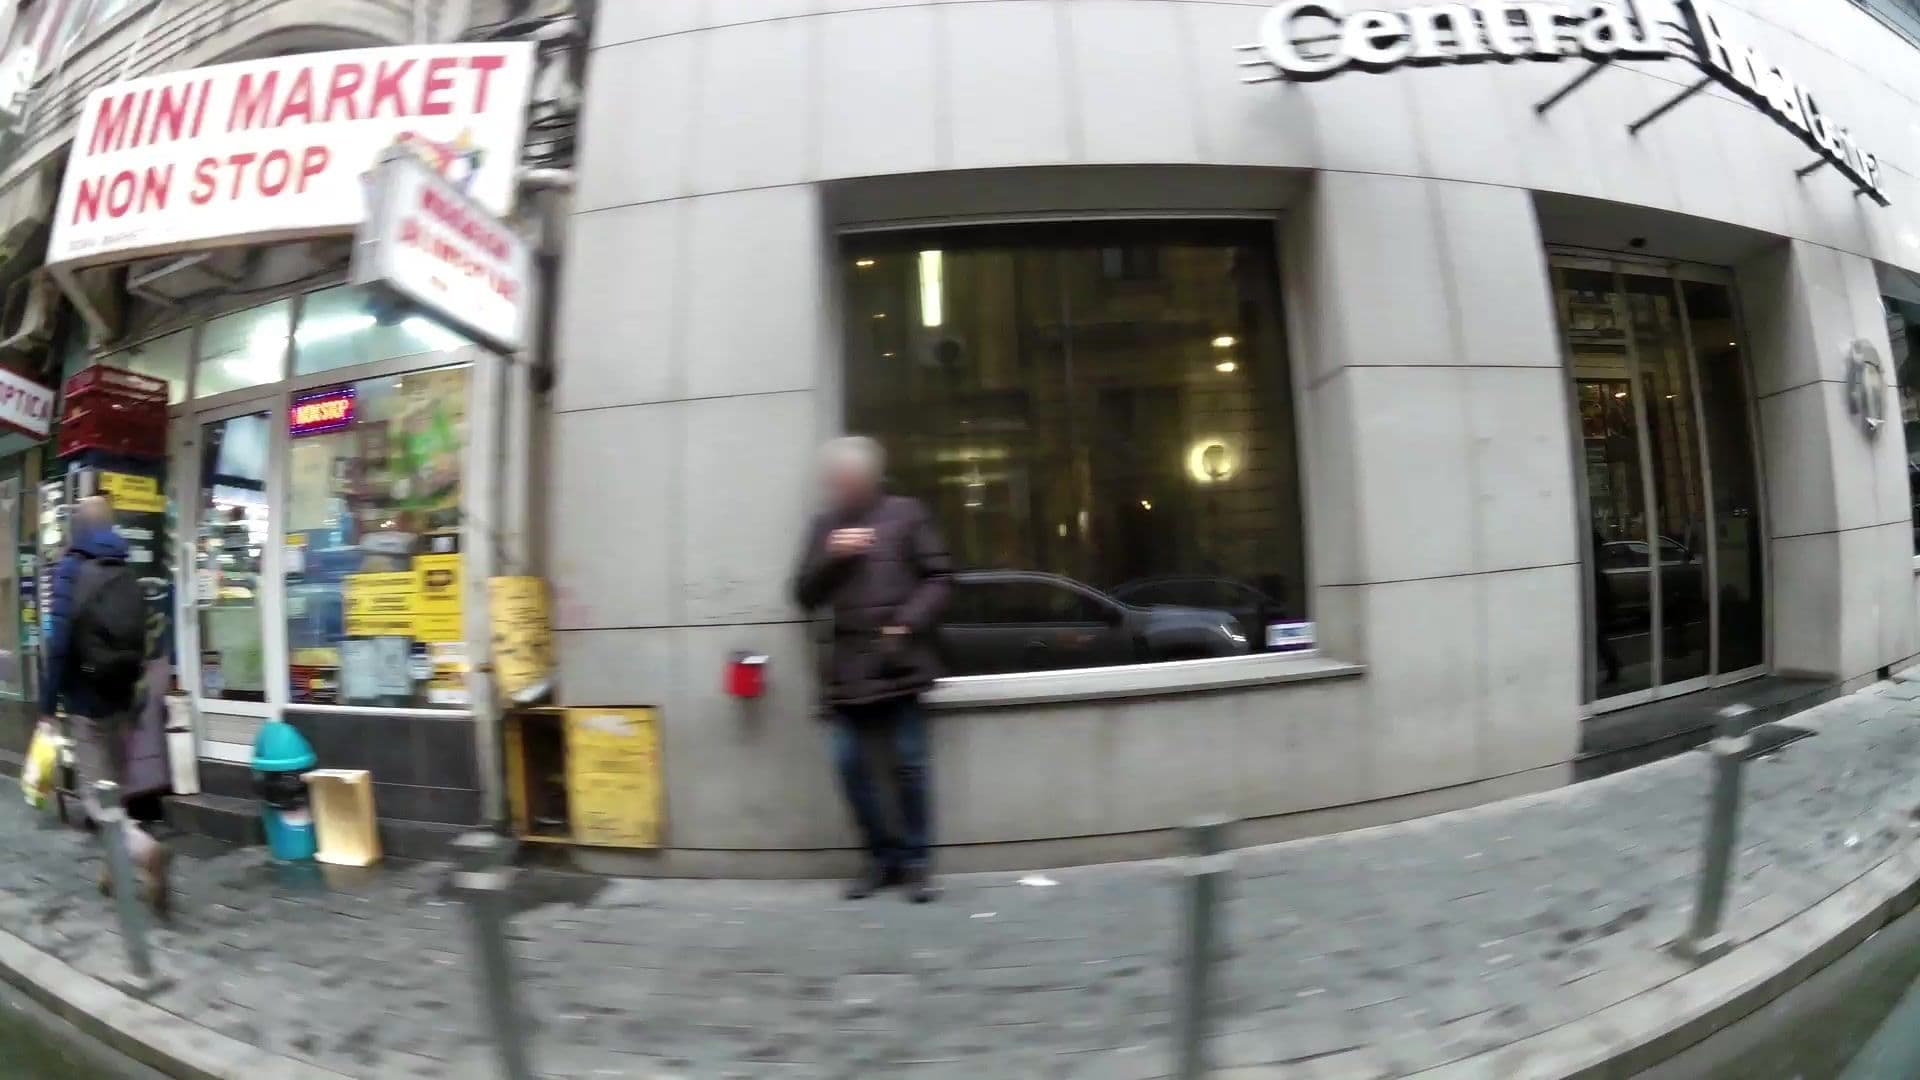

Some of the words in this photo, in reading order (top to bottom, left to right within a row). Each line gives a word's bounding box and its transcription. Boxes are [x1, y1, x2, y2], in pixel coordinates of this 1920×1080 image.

[1259, 0, 1671, 73] Central
[88, 78, 213, 156] MINI
[226, 55, 507, 132] MARKET
[72, 164, 174, 225] NON
[190, 146, 331, 205] STOP
